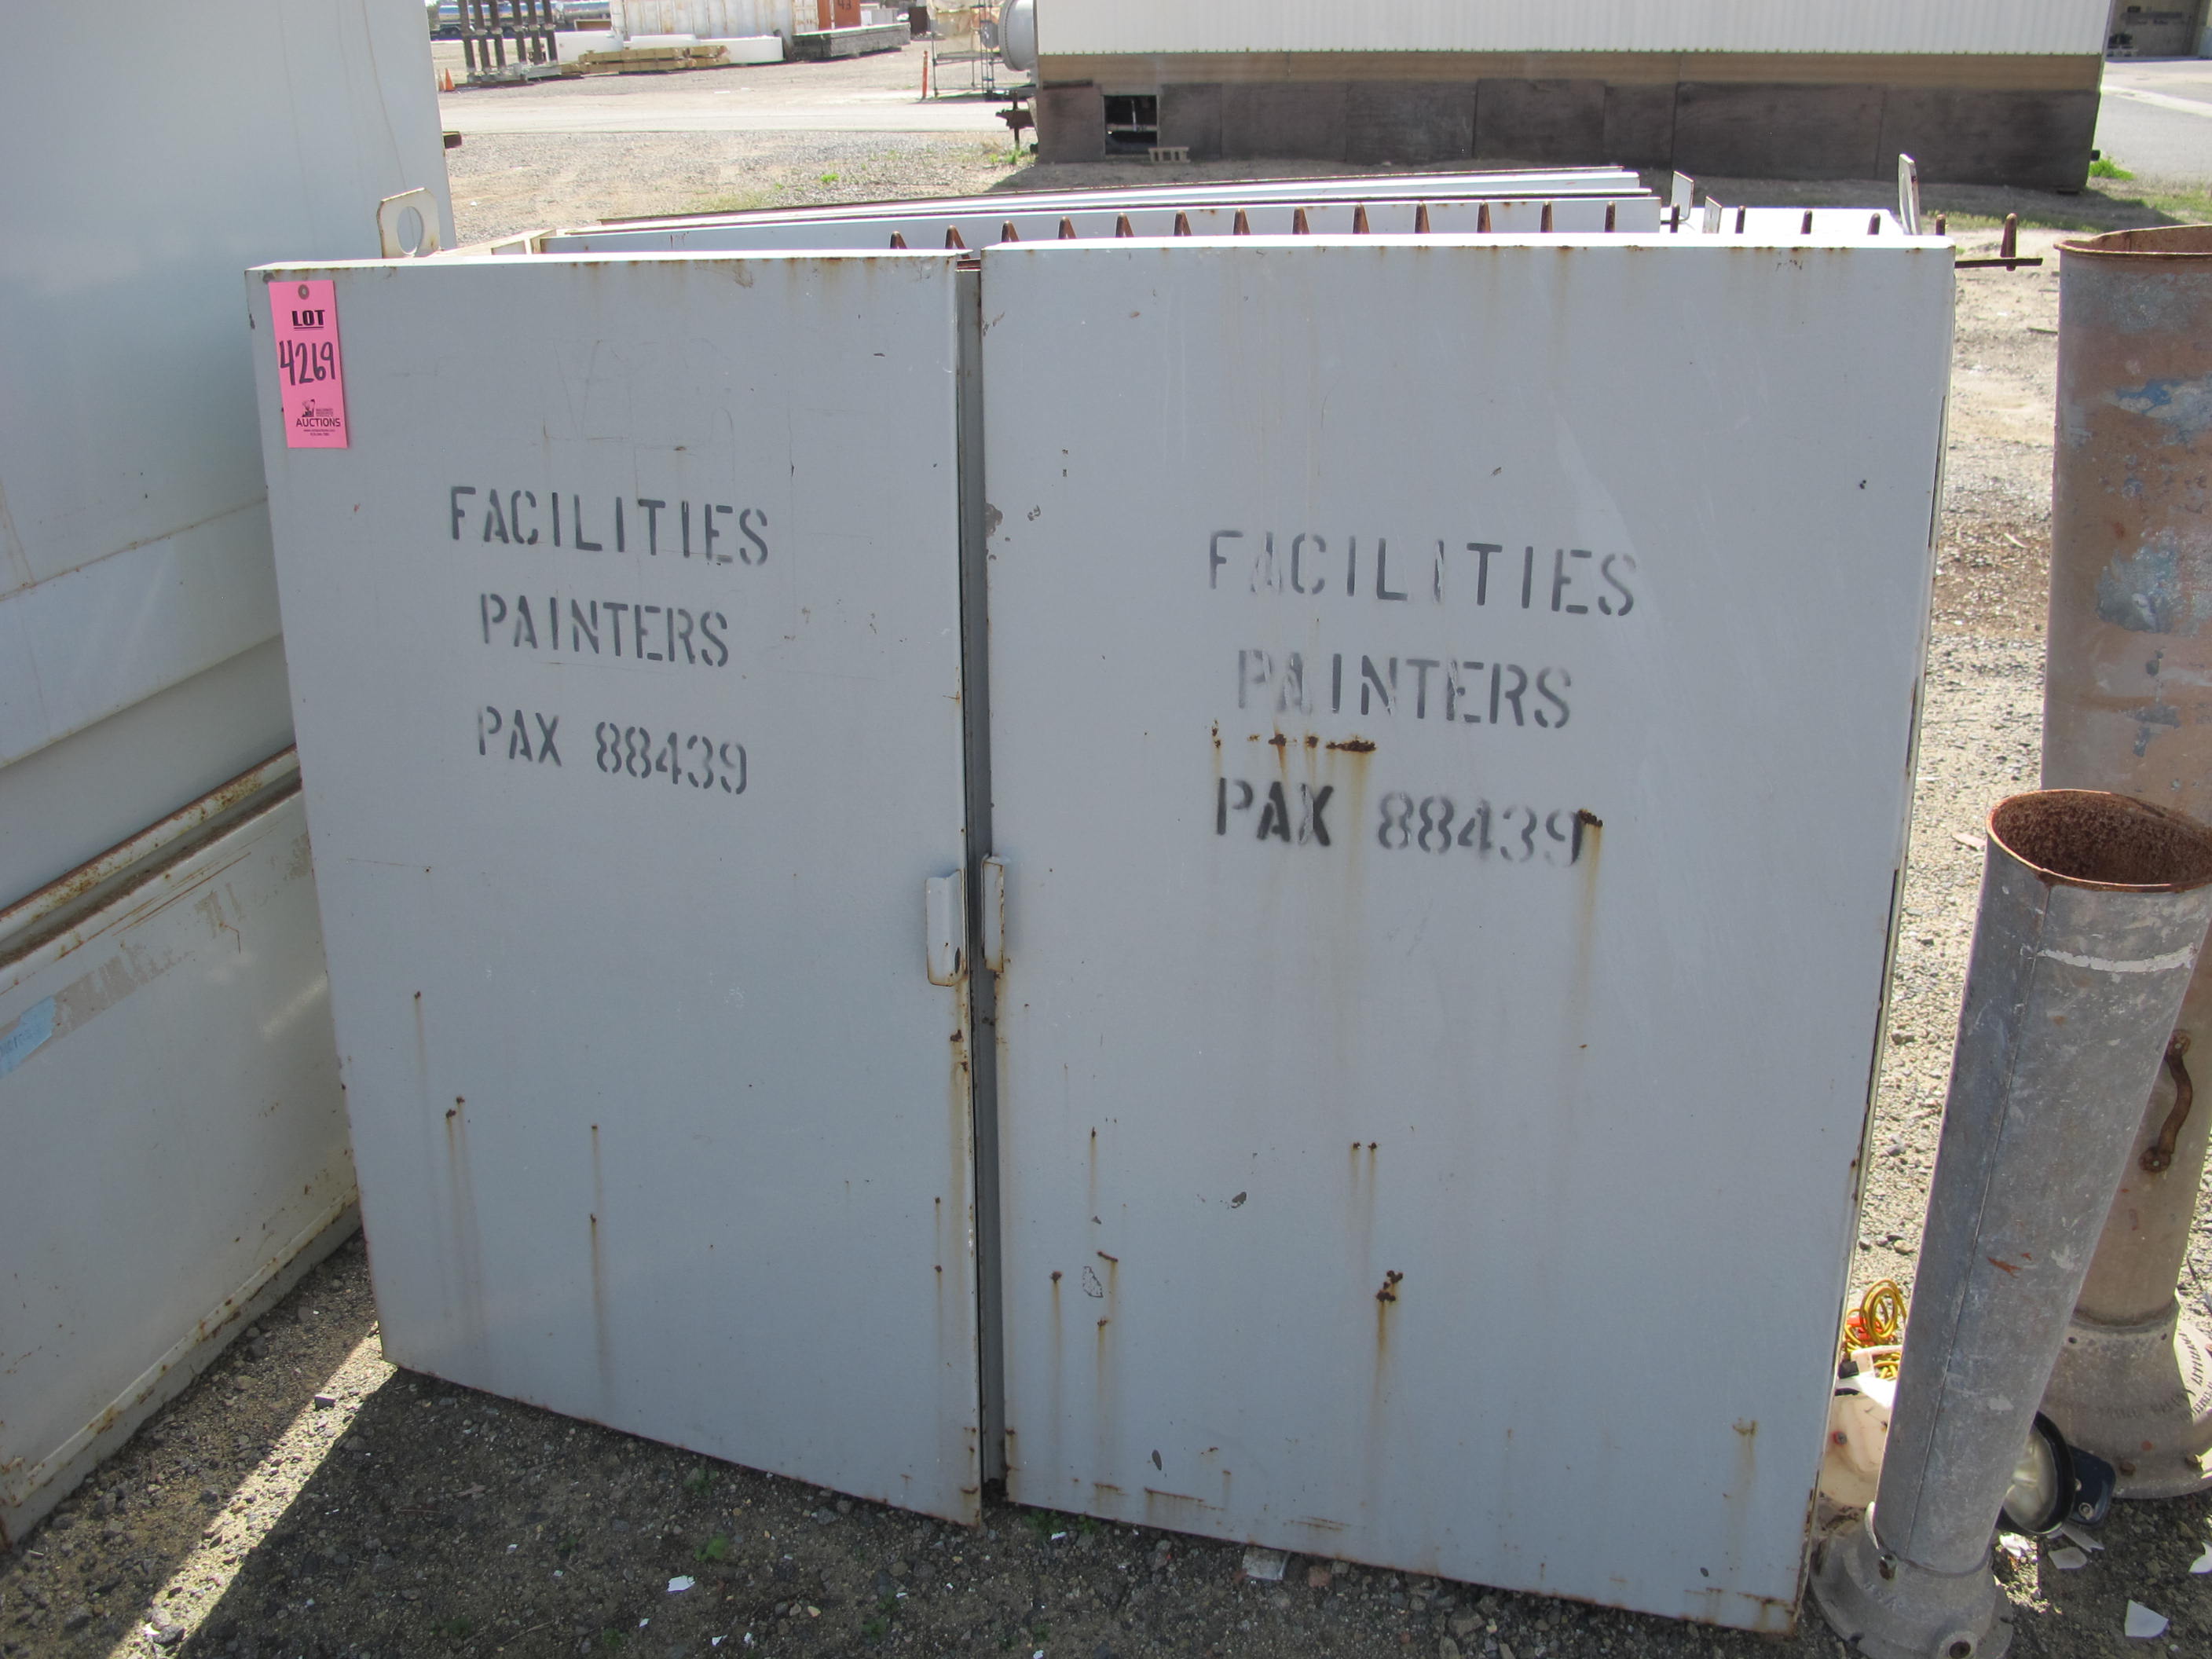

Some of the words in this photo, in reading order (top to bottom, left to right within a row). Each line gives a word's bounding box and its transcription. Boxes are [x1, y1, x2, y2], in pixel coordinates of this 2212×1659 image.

[292, 309, 325, 326] LOT
[279, 339, 335, 386] 4269
[295, 418, 341, 427] AUCTIONS
[451, 485, 767, 566] FACILITIES
[1210, 529, 1636, 616] FACILITIES
[481, 593, 729, 668] PAINTERS
[1238, 650, 1572, 729] PAINTERS
[478, 705, 562, 767] PAX
[595, 721, 747, 795] 88439
[1216, 777, 1335, 847] PAX
[1377, 791, 1582, 866] 88439
